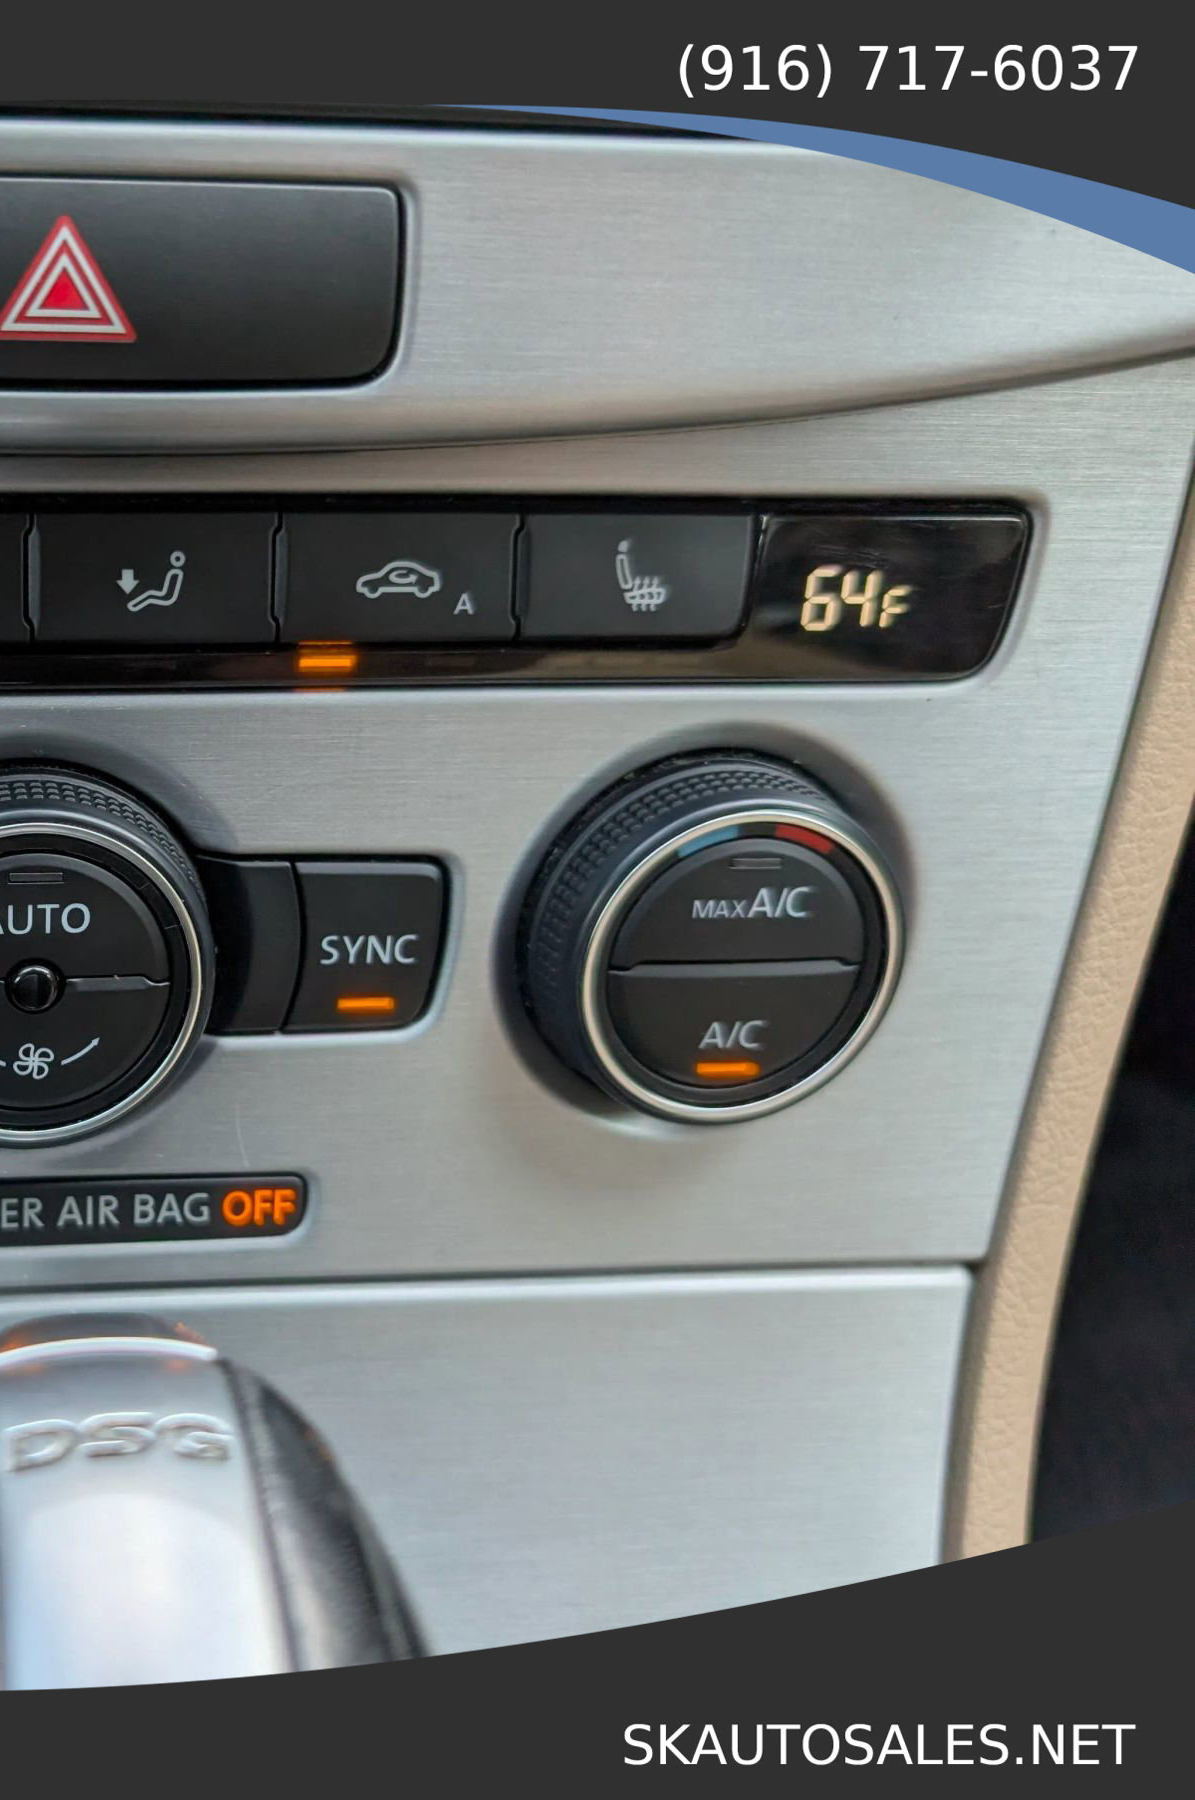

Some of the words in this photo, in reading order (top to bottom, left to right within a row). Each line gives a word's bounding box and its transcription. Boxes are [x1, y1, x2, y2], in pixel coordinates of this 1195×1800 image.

[453, 593, 476, 615] A
[691, 899, 748, 919] MAX
[747, 886, 816, 920] A/C
[320, 934, 419, 965] SYNC
[698, 1019, 770, 1049] A/C
[56, 1196, 120, 1226] AIR
[133, 1193, 210, 1225] BAG
[222, 1188, 296, 1226] OFF
[4, 1411, 234, 1472] DSG
